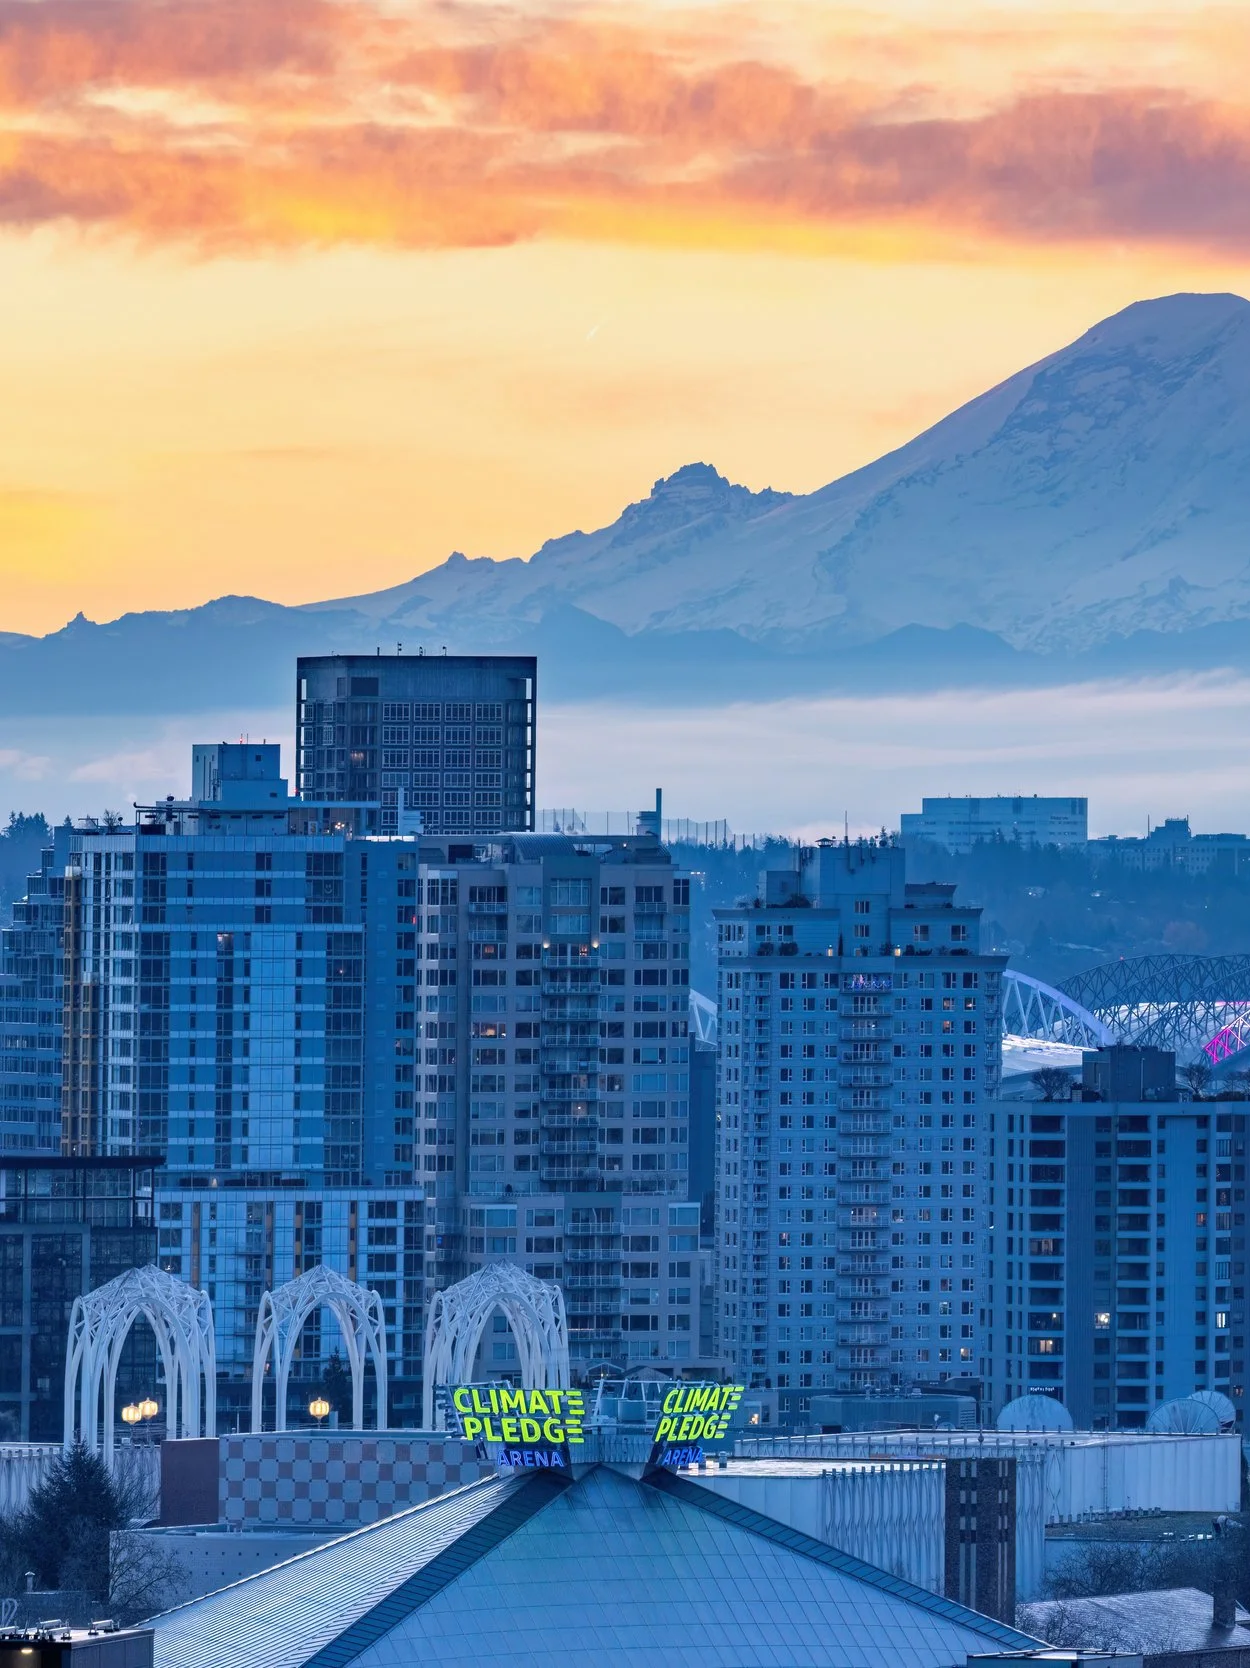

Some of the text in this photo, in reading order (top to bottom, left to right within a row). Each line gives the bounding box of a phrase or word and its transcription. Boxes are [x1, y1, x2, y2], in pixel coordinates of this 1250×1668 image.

[454, 1388, 585, 1415] CLIMATE
[662, 1386, 745, 1414] CLIMATE
[463, 1417, 585, 1443] PLEDGE
[655, 1413, 731, 1443] PLEDGE
[497, 1450, 564, 1467] ARENA
[662, 1447, 703, 1466] ARENA
